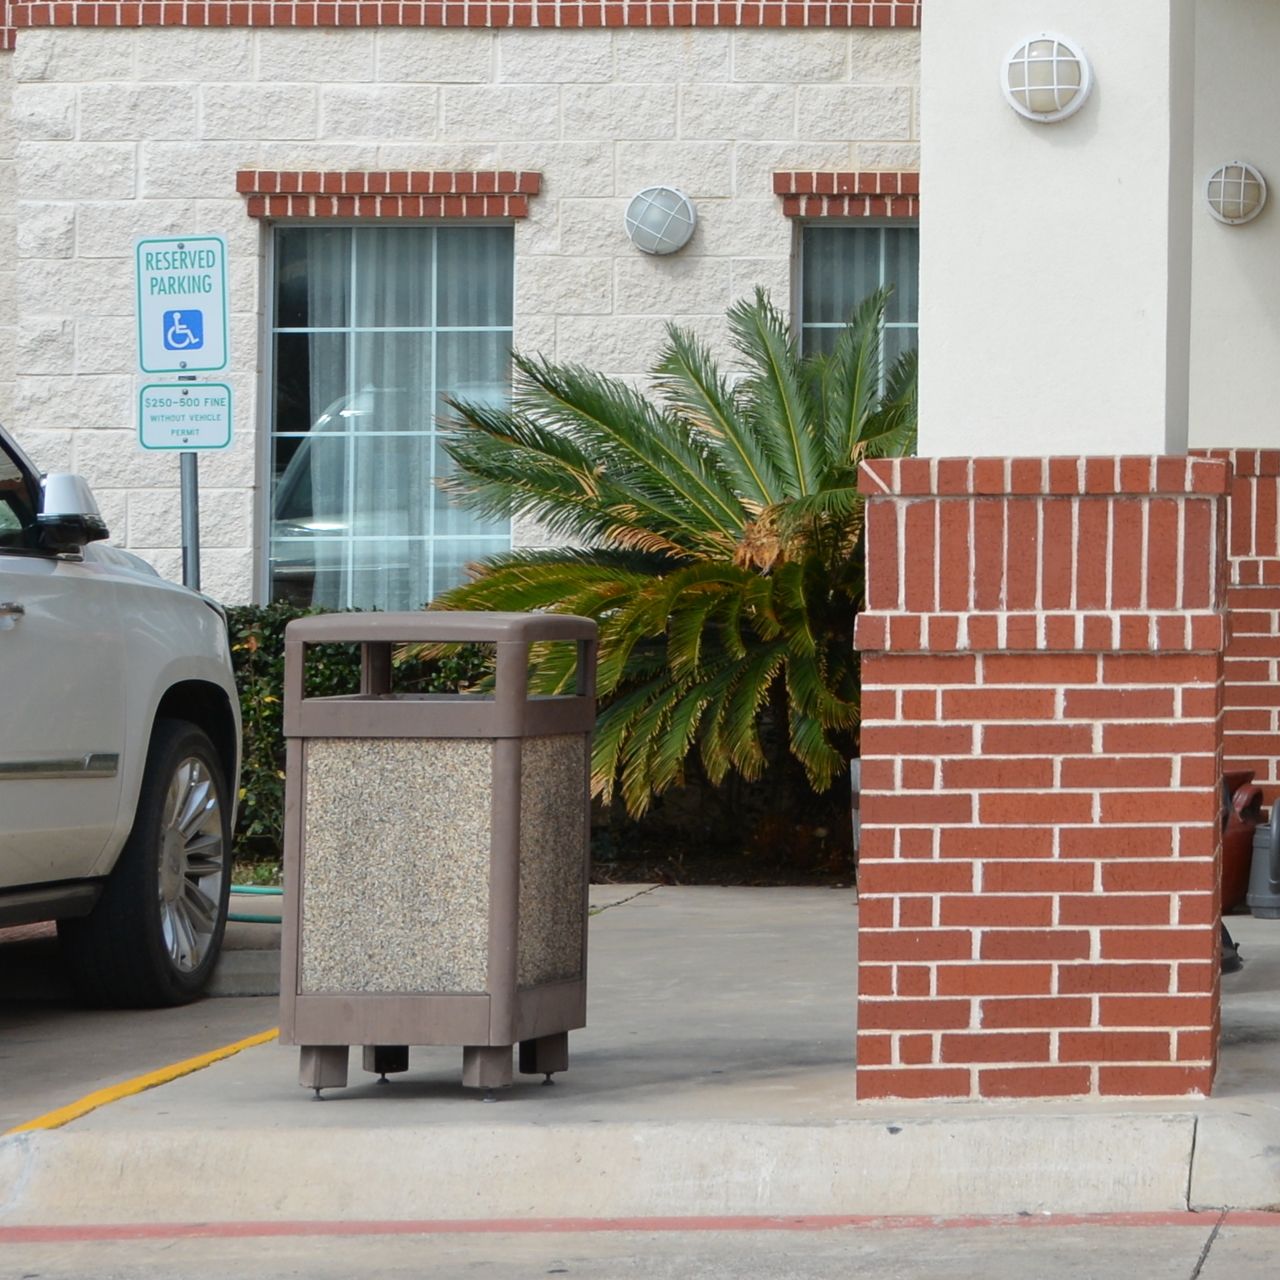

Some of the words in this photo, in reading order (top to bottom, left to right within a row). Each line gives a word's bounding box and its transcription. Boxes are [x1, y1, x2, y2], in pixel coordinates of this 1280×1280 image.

[146, 250, 215, 270] RESERVED
[150, 275, 212, 295] PARKING
[145, 398, 200, 408] $250-500
[204, 398, 226, 407] FINE
[150, 414, 185, 422] WITHOUT
[189, 414, 221, 422] VEHICLE
